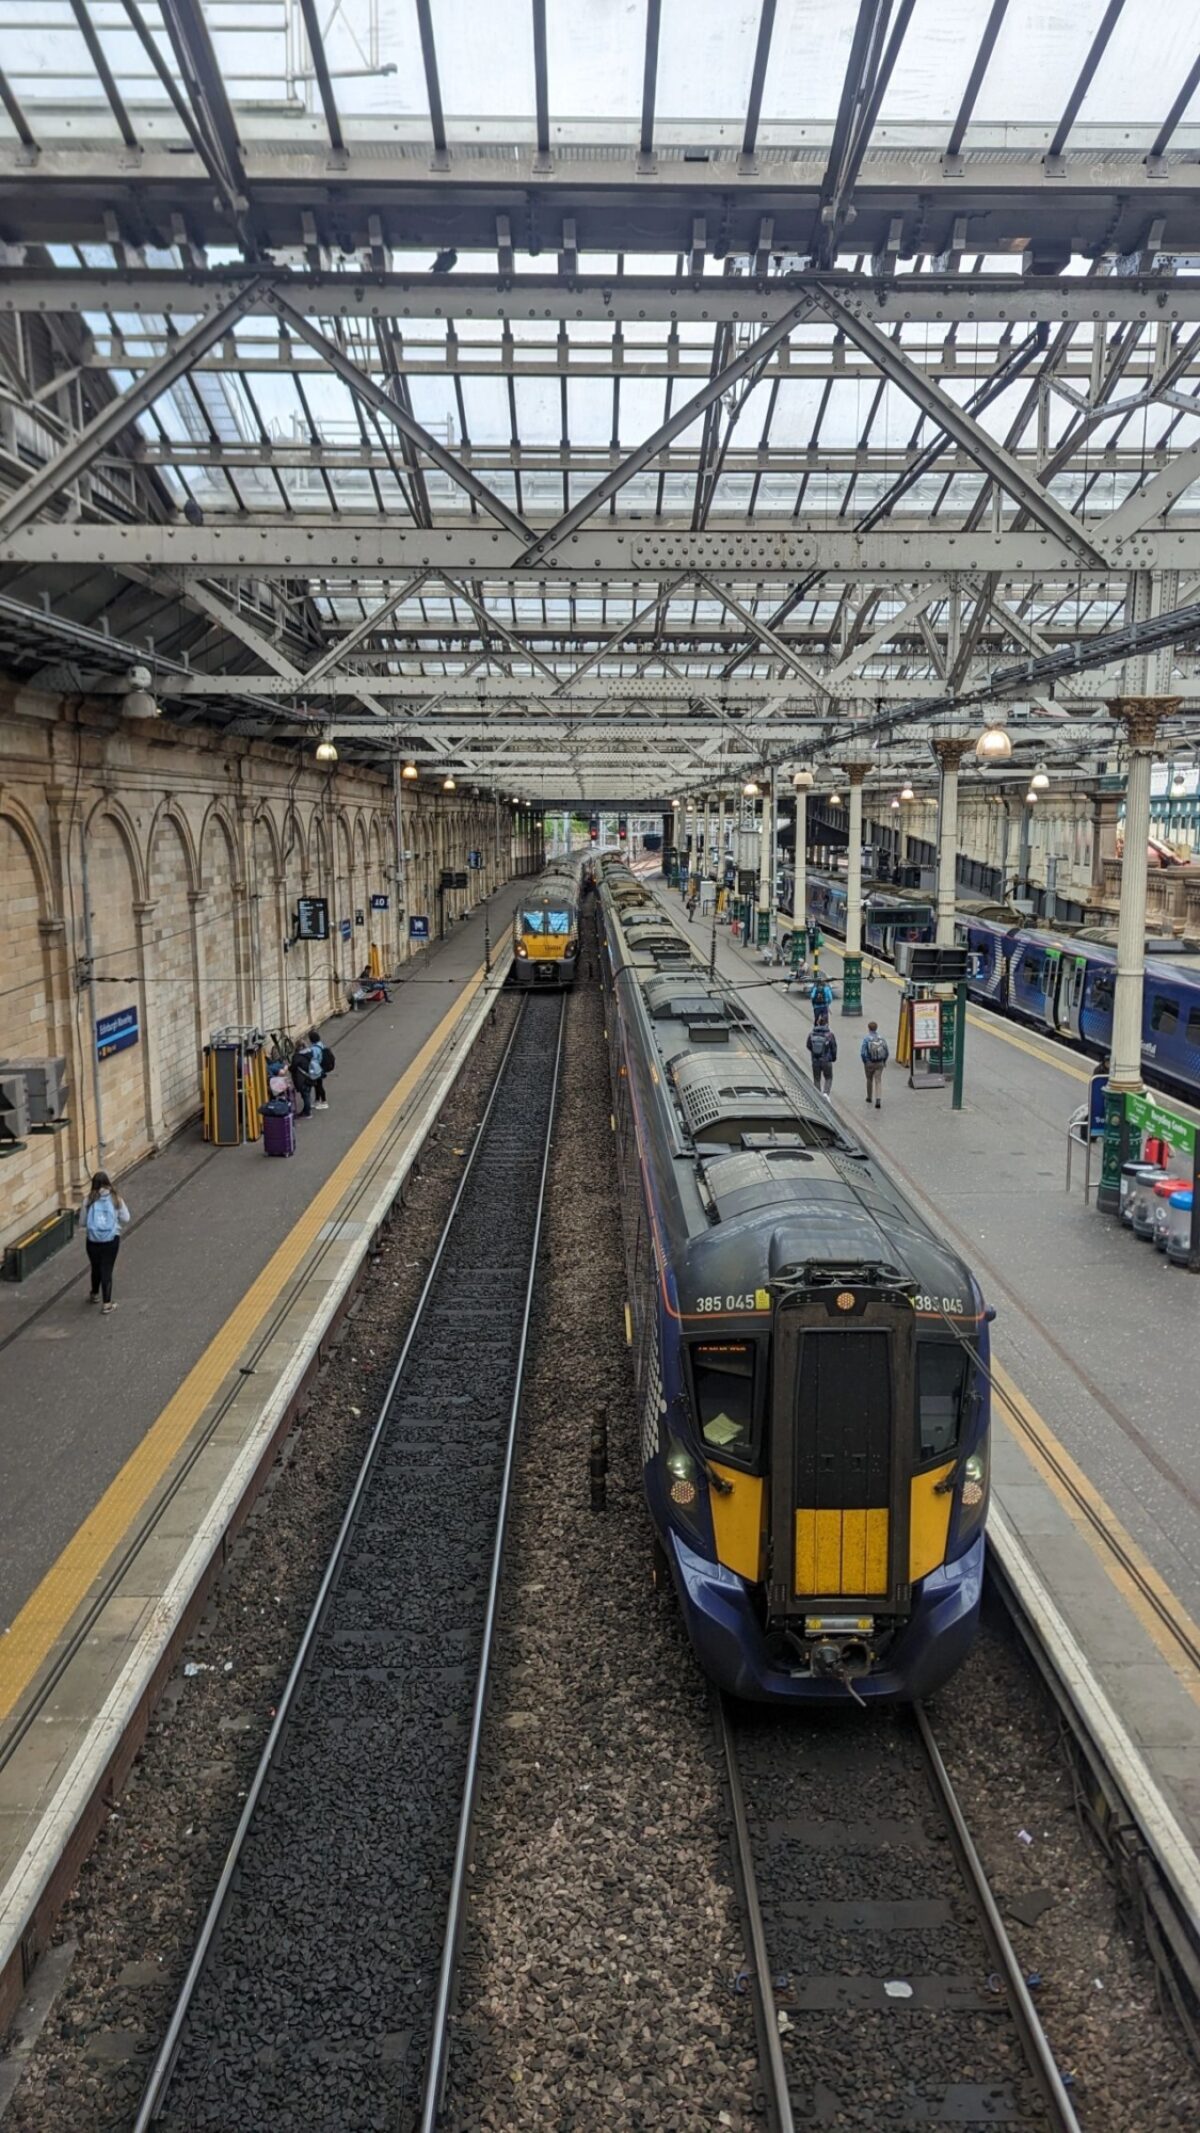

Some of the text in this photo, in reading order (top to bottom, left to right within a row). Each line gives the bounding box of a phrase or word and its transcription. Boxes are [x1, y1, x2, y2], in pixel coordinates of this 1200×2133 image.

[374, 898, 385, 906] 10
[696, 1294, 755, 1312] 385 045
[915, 1295, 963, 1314] 385 045
